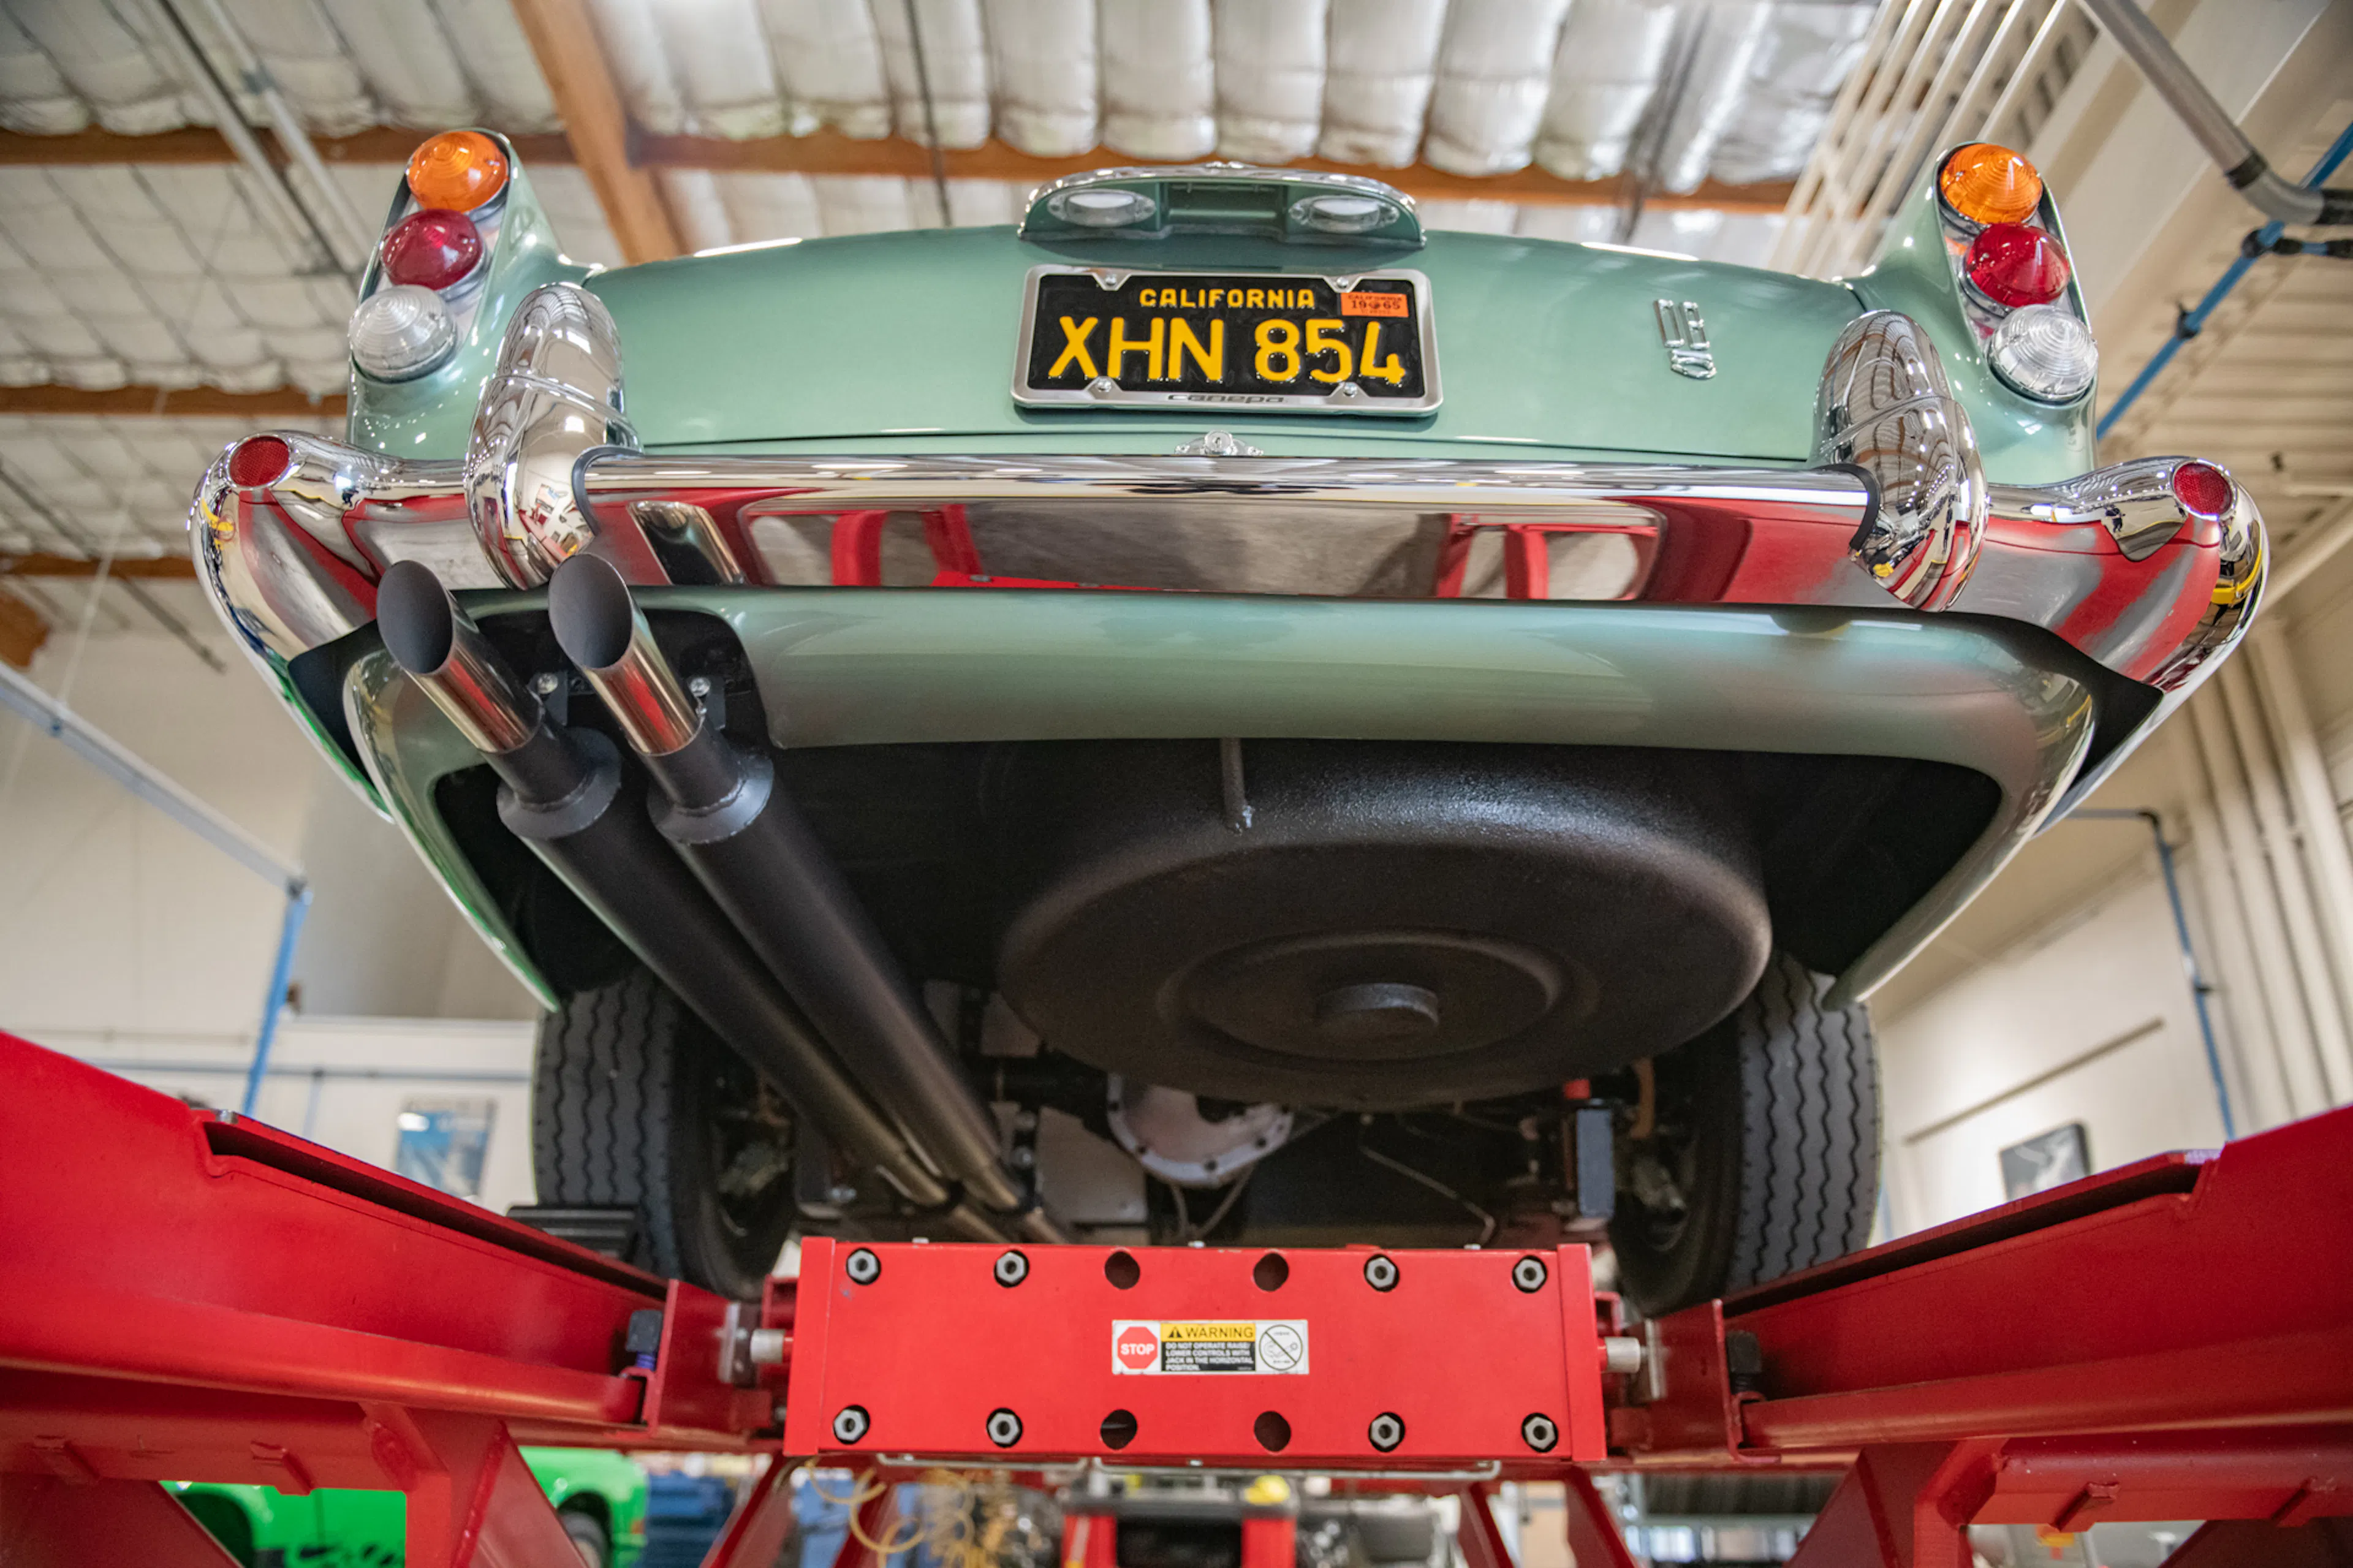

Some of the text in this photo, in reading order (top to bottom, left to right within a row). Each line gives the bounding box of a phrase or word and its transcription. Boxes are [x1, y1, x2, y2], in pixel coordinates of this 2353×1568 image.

[1140, 289, 1315, 308] CALIFORNIA
[1352, 300, 1366, 309] 19
[1048, 316, 1406, 385] XHN 854
[1168, 394, 1285, 404] canepa
[1185, 1327, 1253, 1338] WARNING
[1121, 1343, 1154, 1355] STOP
